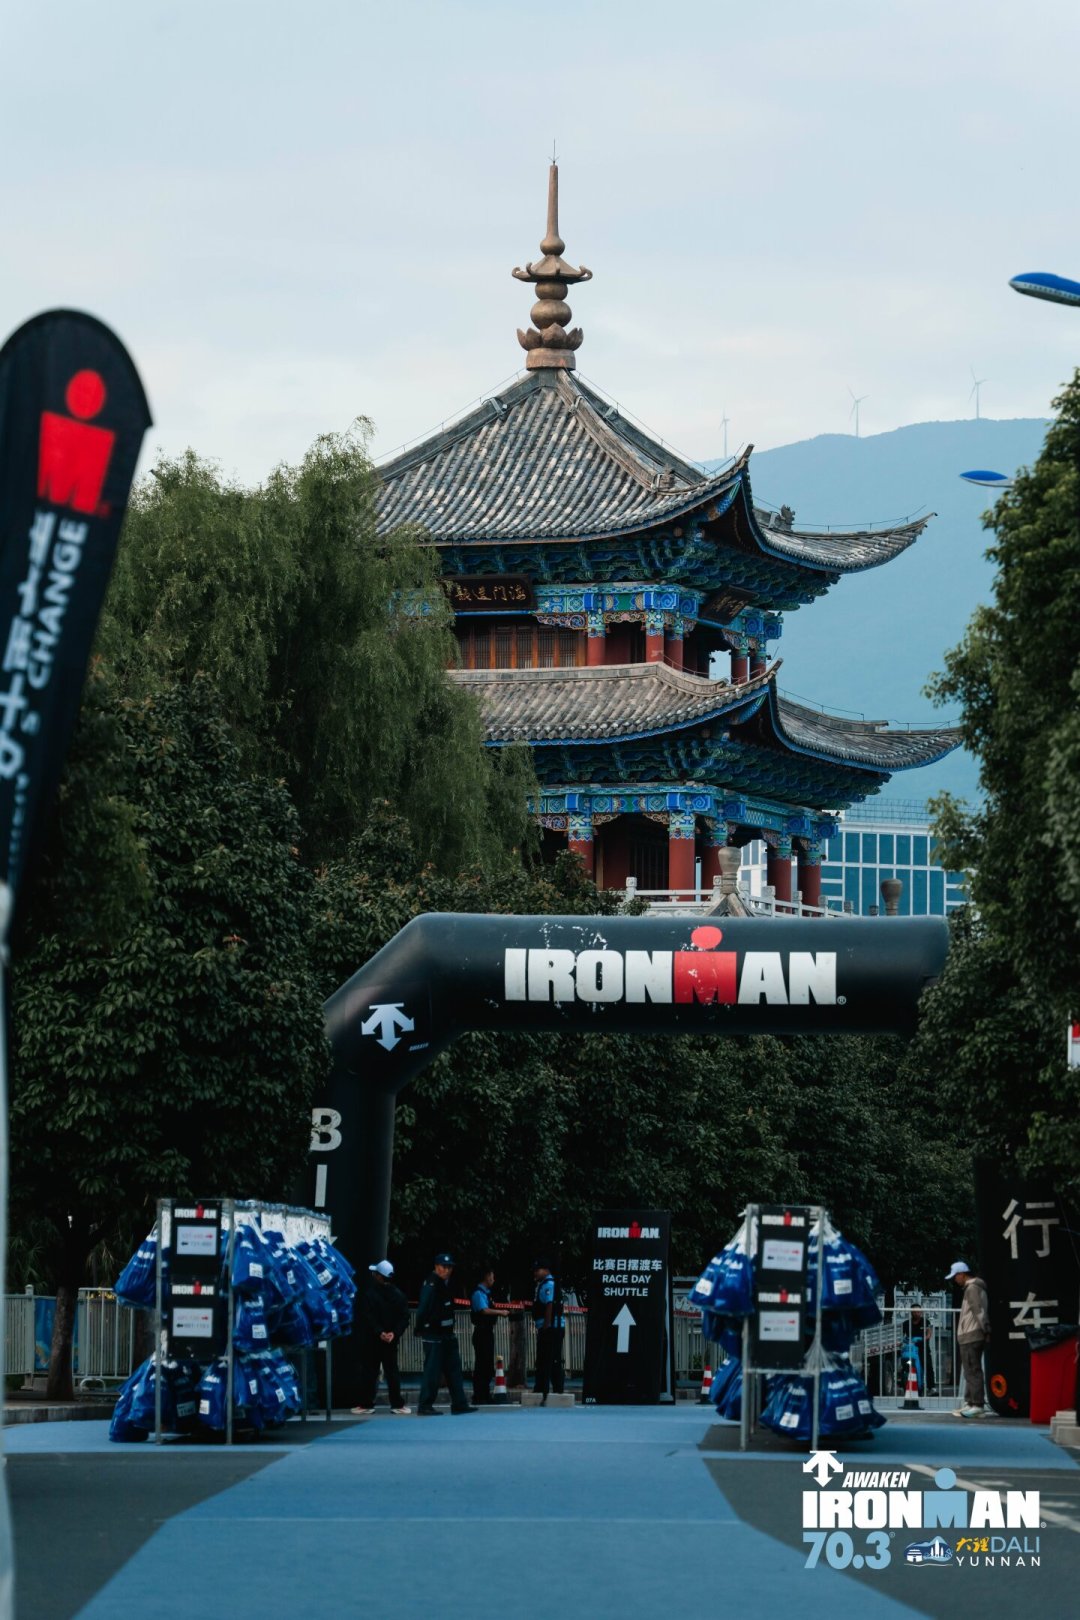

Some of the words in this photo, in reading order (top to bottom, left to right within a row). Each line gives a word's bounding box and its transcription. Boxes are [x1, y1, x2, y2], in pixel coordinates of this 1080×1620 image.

[27, 517, 88, 690] CHANGE
[504, 947, 837, 1005] IRONMAN
[597, 1227, 660, 1239] IRONMAN
[593, 1258, 663, 1272] 比赛日摆渡车
[602, 1274, 629, 1284] RACE
[631, 1274, 652, 1284] DAY
[603, 1287, 649, 1297] SHUTTLE
